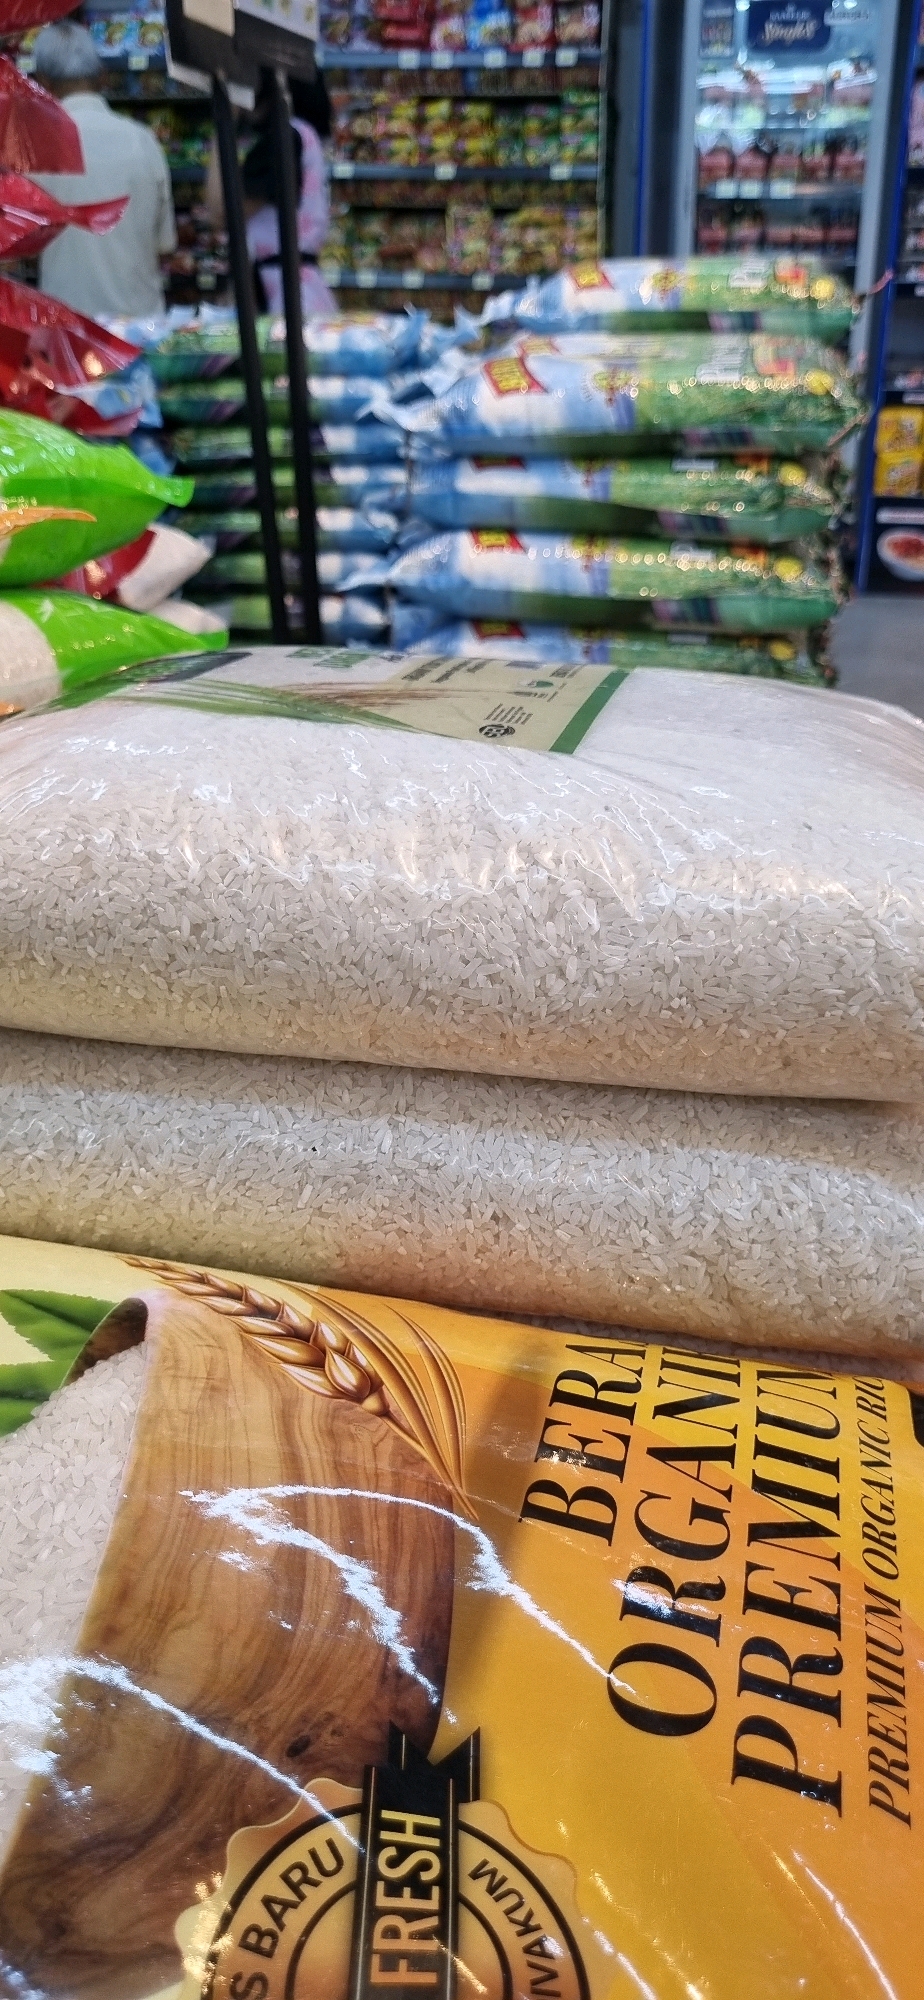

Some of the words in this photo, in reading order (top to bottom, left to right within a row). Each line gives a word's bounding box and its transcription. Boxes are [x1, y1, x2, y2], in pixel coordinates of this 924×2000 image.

[518, 1340, 649, 1546] BERA
[852, 1375, 888, 1423] RIC
[857, 1418, 899, 1580] ORGANIC
[863, 1582, 911, 1830] PREMIUM
[238, 1837, 345, 1959] BARU
[370, 1809, 441, 1983] FRESH
[468, 1858, 562, 2000] IVAKUM
